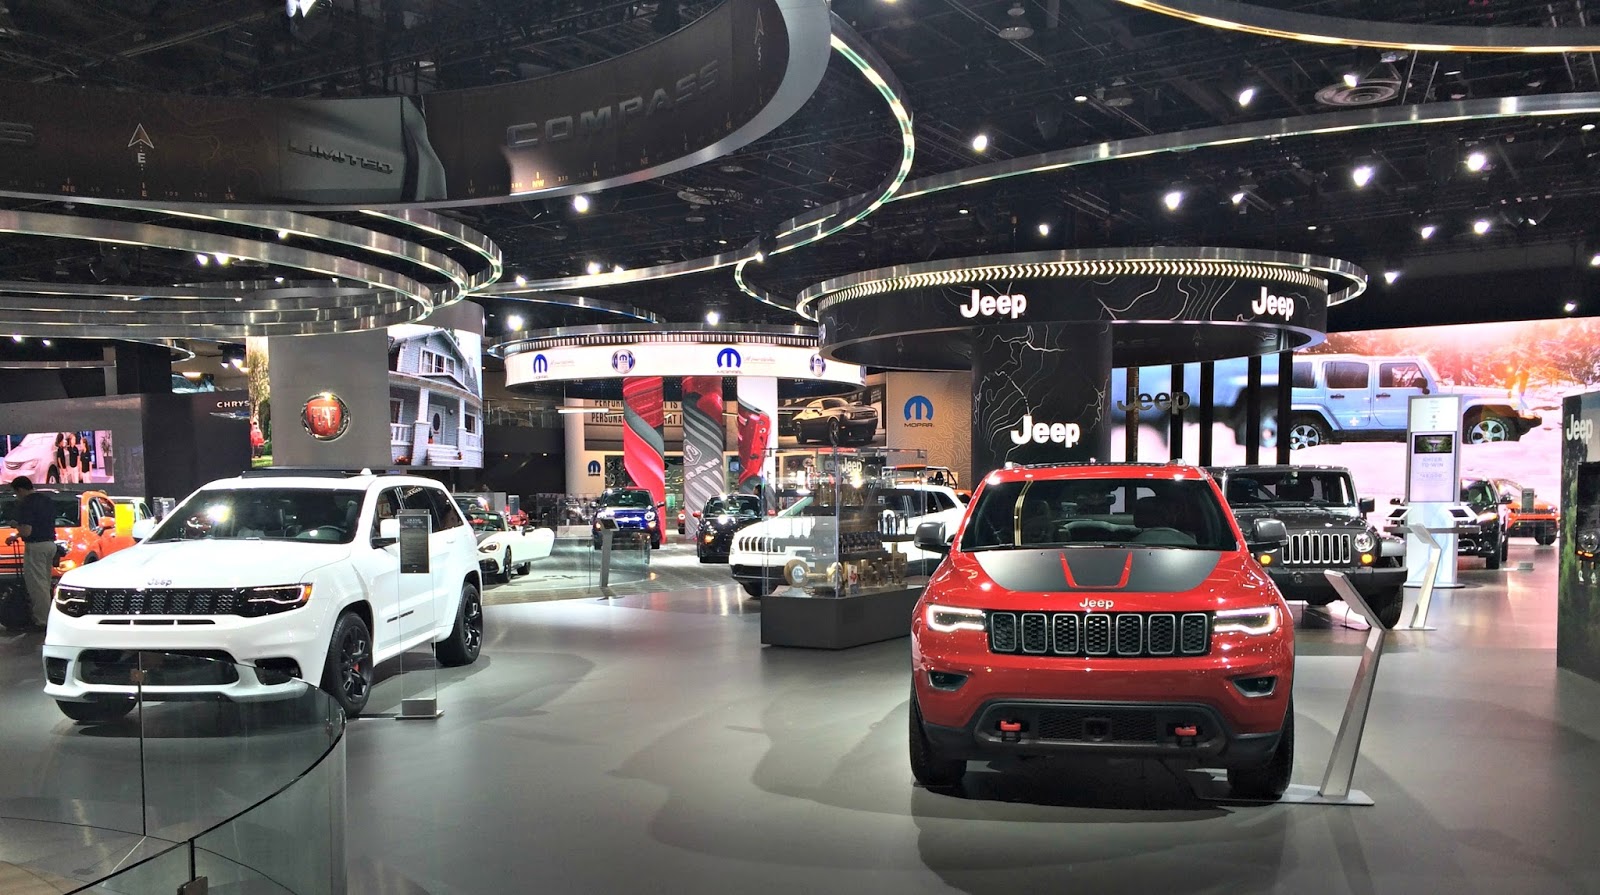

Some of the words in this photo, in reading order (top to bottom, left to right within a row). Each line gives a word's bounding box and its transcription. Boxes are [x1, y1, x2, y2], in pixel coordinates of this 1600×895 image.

[507, 59, 719, 148] COMPASS
[137, 152, 146, 163] E
[288, 140, 393, 174] LIMITED
[62, 185, 76, 193] NE
[532, 179, 545, 188] NW
[960, 289, 1027, 319] Jeep
[1252, 286, 1294, 321] Jeep
[1117, 387, 1191, 415] Jeep
[311, 406, 337, 429] FIAT
[1567, 413, 1593, 444] Jeep
[1010, 414, 1081, 448] Jeep
[685, 458, 721, 481] RAM
[841, 458, 863, 472] Jeep
[147, 578, 173, 586] Jeep
[1079, 597, 1114, 609] Jeep
